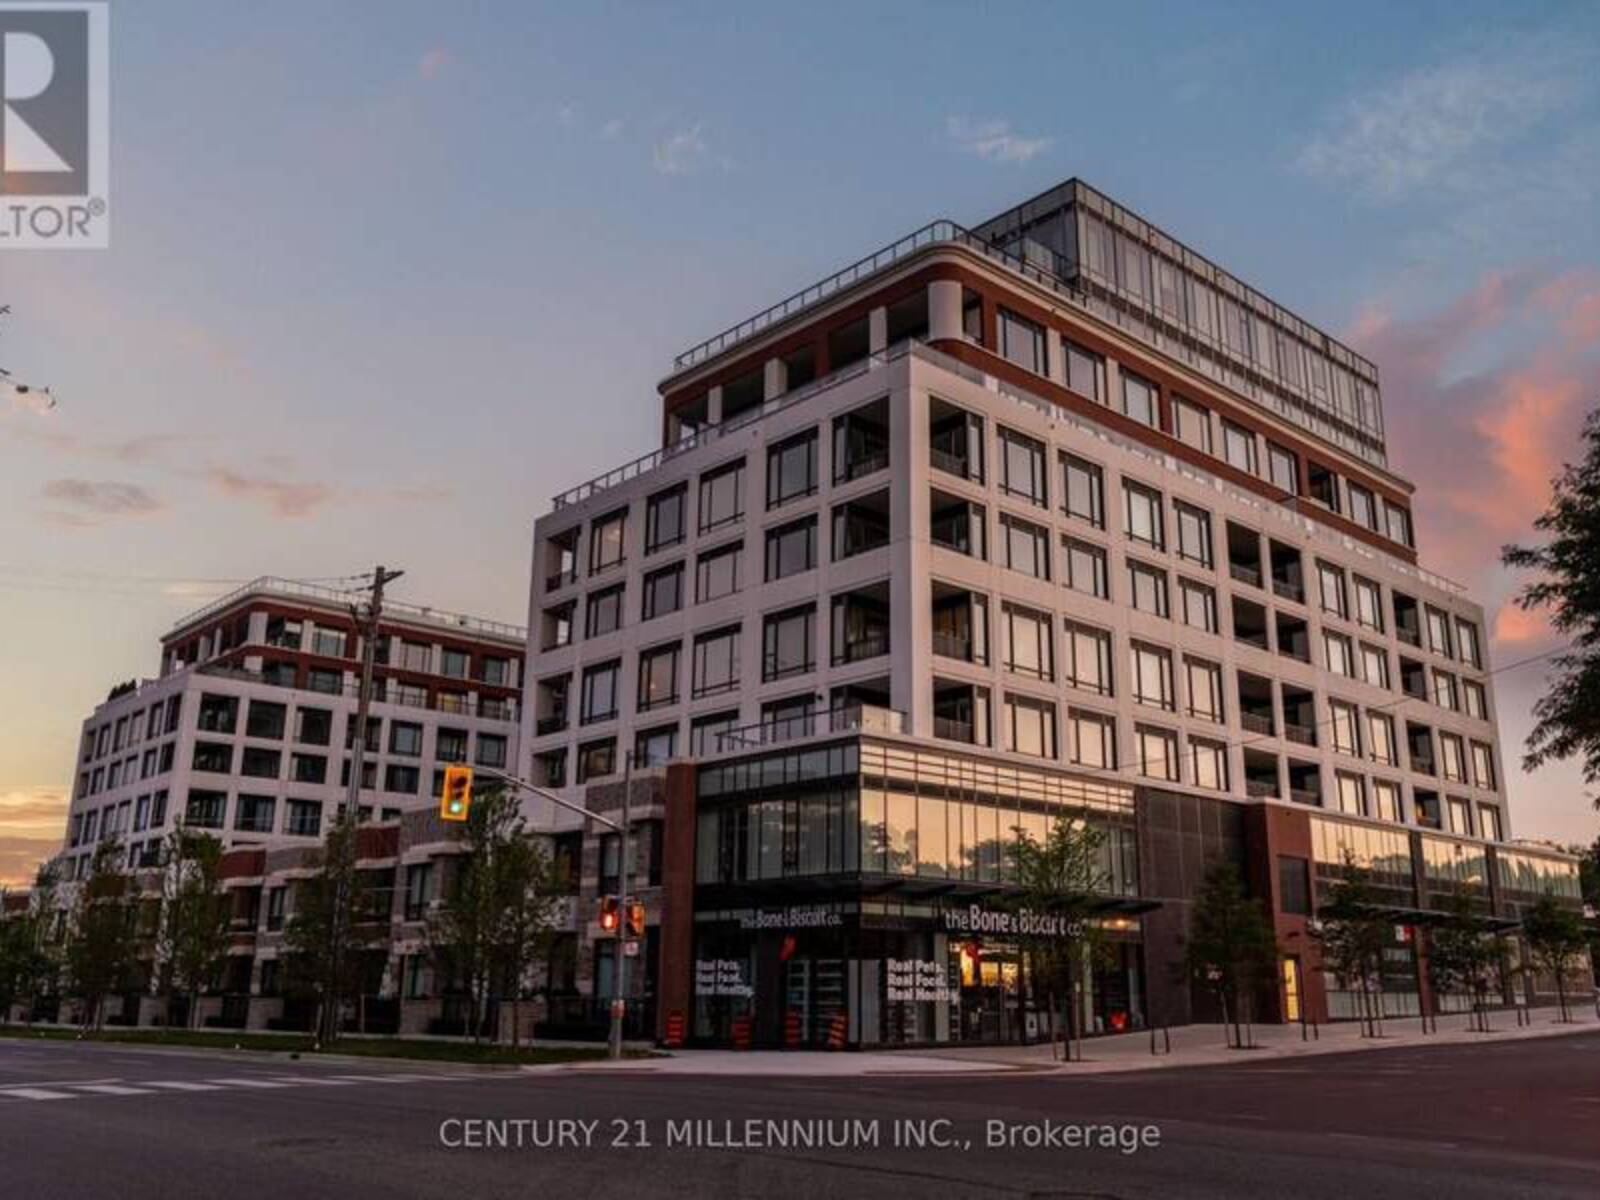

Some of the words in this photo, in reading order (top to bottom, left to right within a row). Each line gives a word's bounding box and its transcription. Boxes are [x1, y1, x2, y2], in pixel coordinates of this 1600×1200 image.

[945, 911, 969, 930] the
[969, 904, 1009, 933] Bone
[887, 958, 913, 972] Real
[887, 973, 913, 986] Real
[887, 987, 913, 1001] Real
